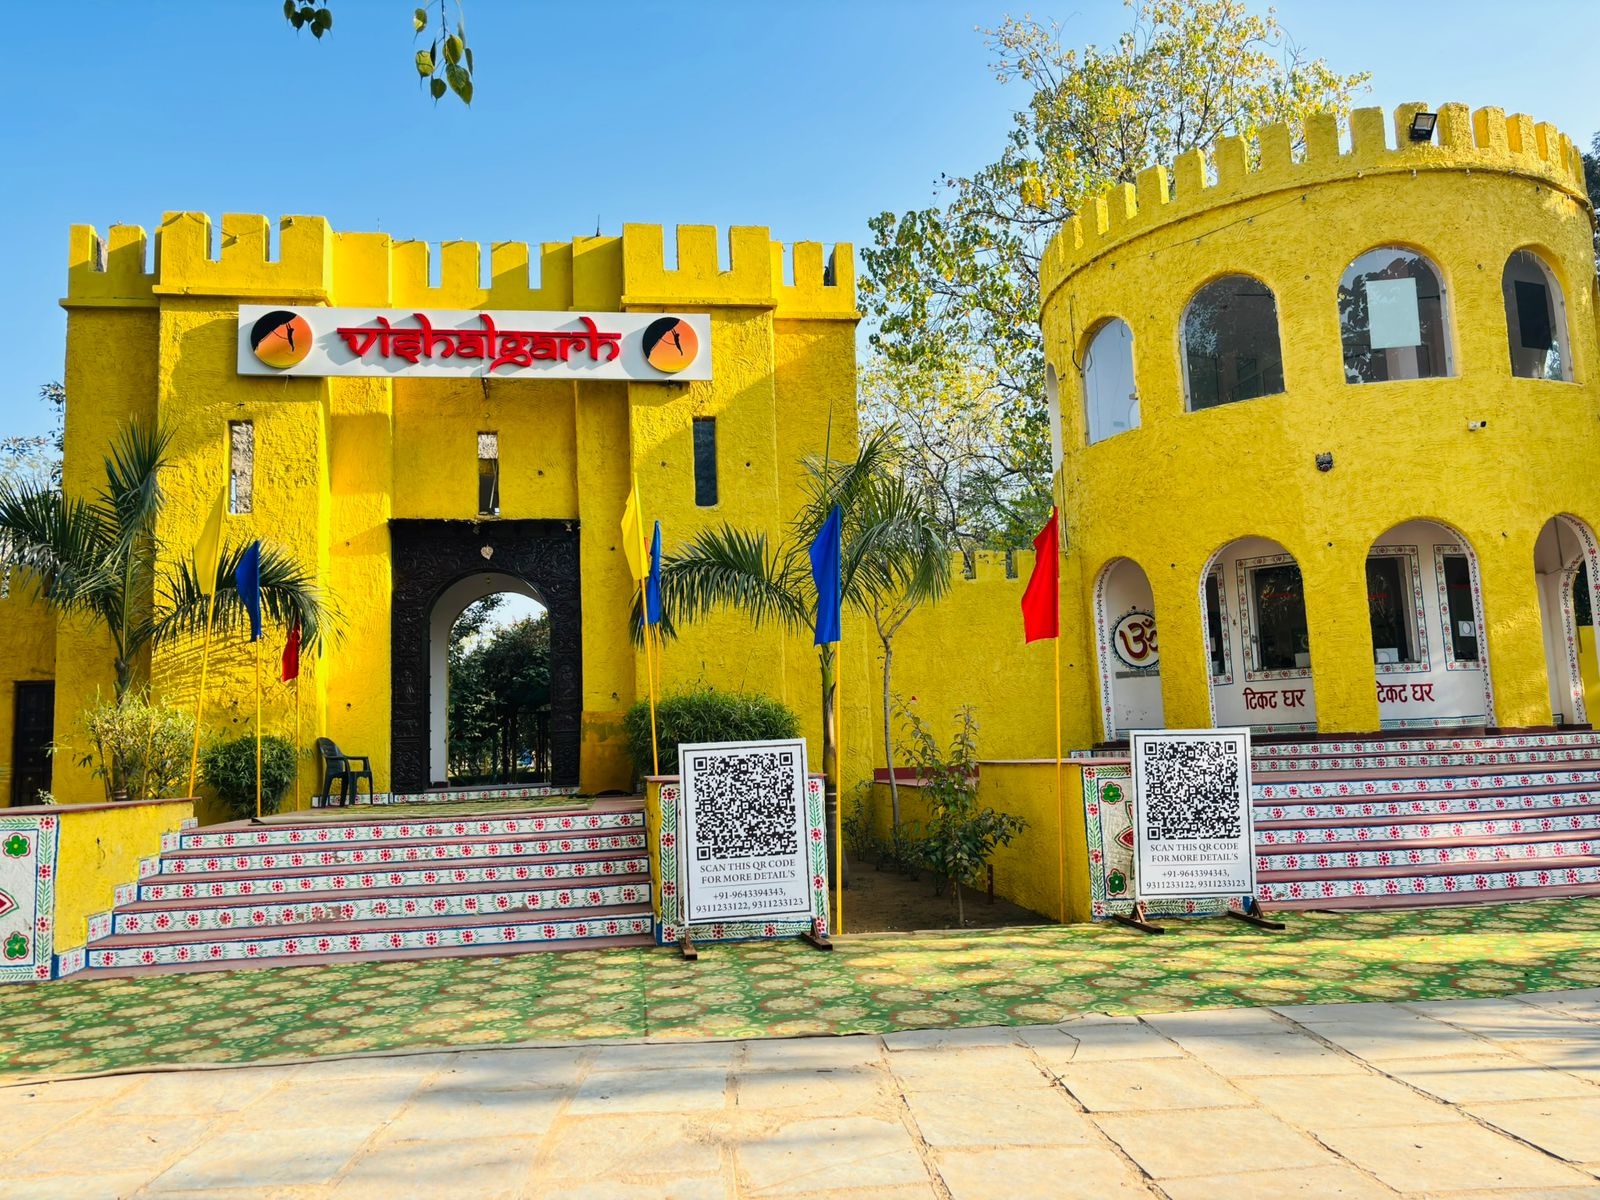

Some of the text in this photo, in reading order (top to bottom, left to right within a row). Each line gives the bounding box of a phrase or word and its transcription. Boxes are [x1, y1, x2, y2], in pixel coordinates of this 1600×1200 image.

[337, 313, 621, 373] vishalgarh
[1243, 687, 1306, 710] टिकट घर
[1410, 683, 1435, 702] घर
[1150, 842, 1239, 852] SCAN THIS QR CODE
[1151, 853, 1239, 862] FOR MORE DETAIL'S
[700, 859, 796, 873] SCAN THIS QR CODE
[701, 870, 796, 884] FOR MORE DETAIL'S
[1198, 879, 1246, 888] 9311233123
[752, 897, 804, 909] 9311233123
